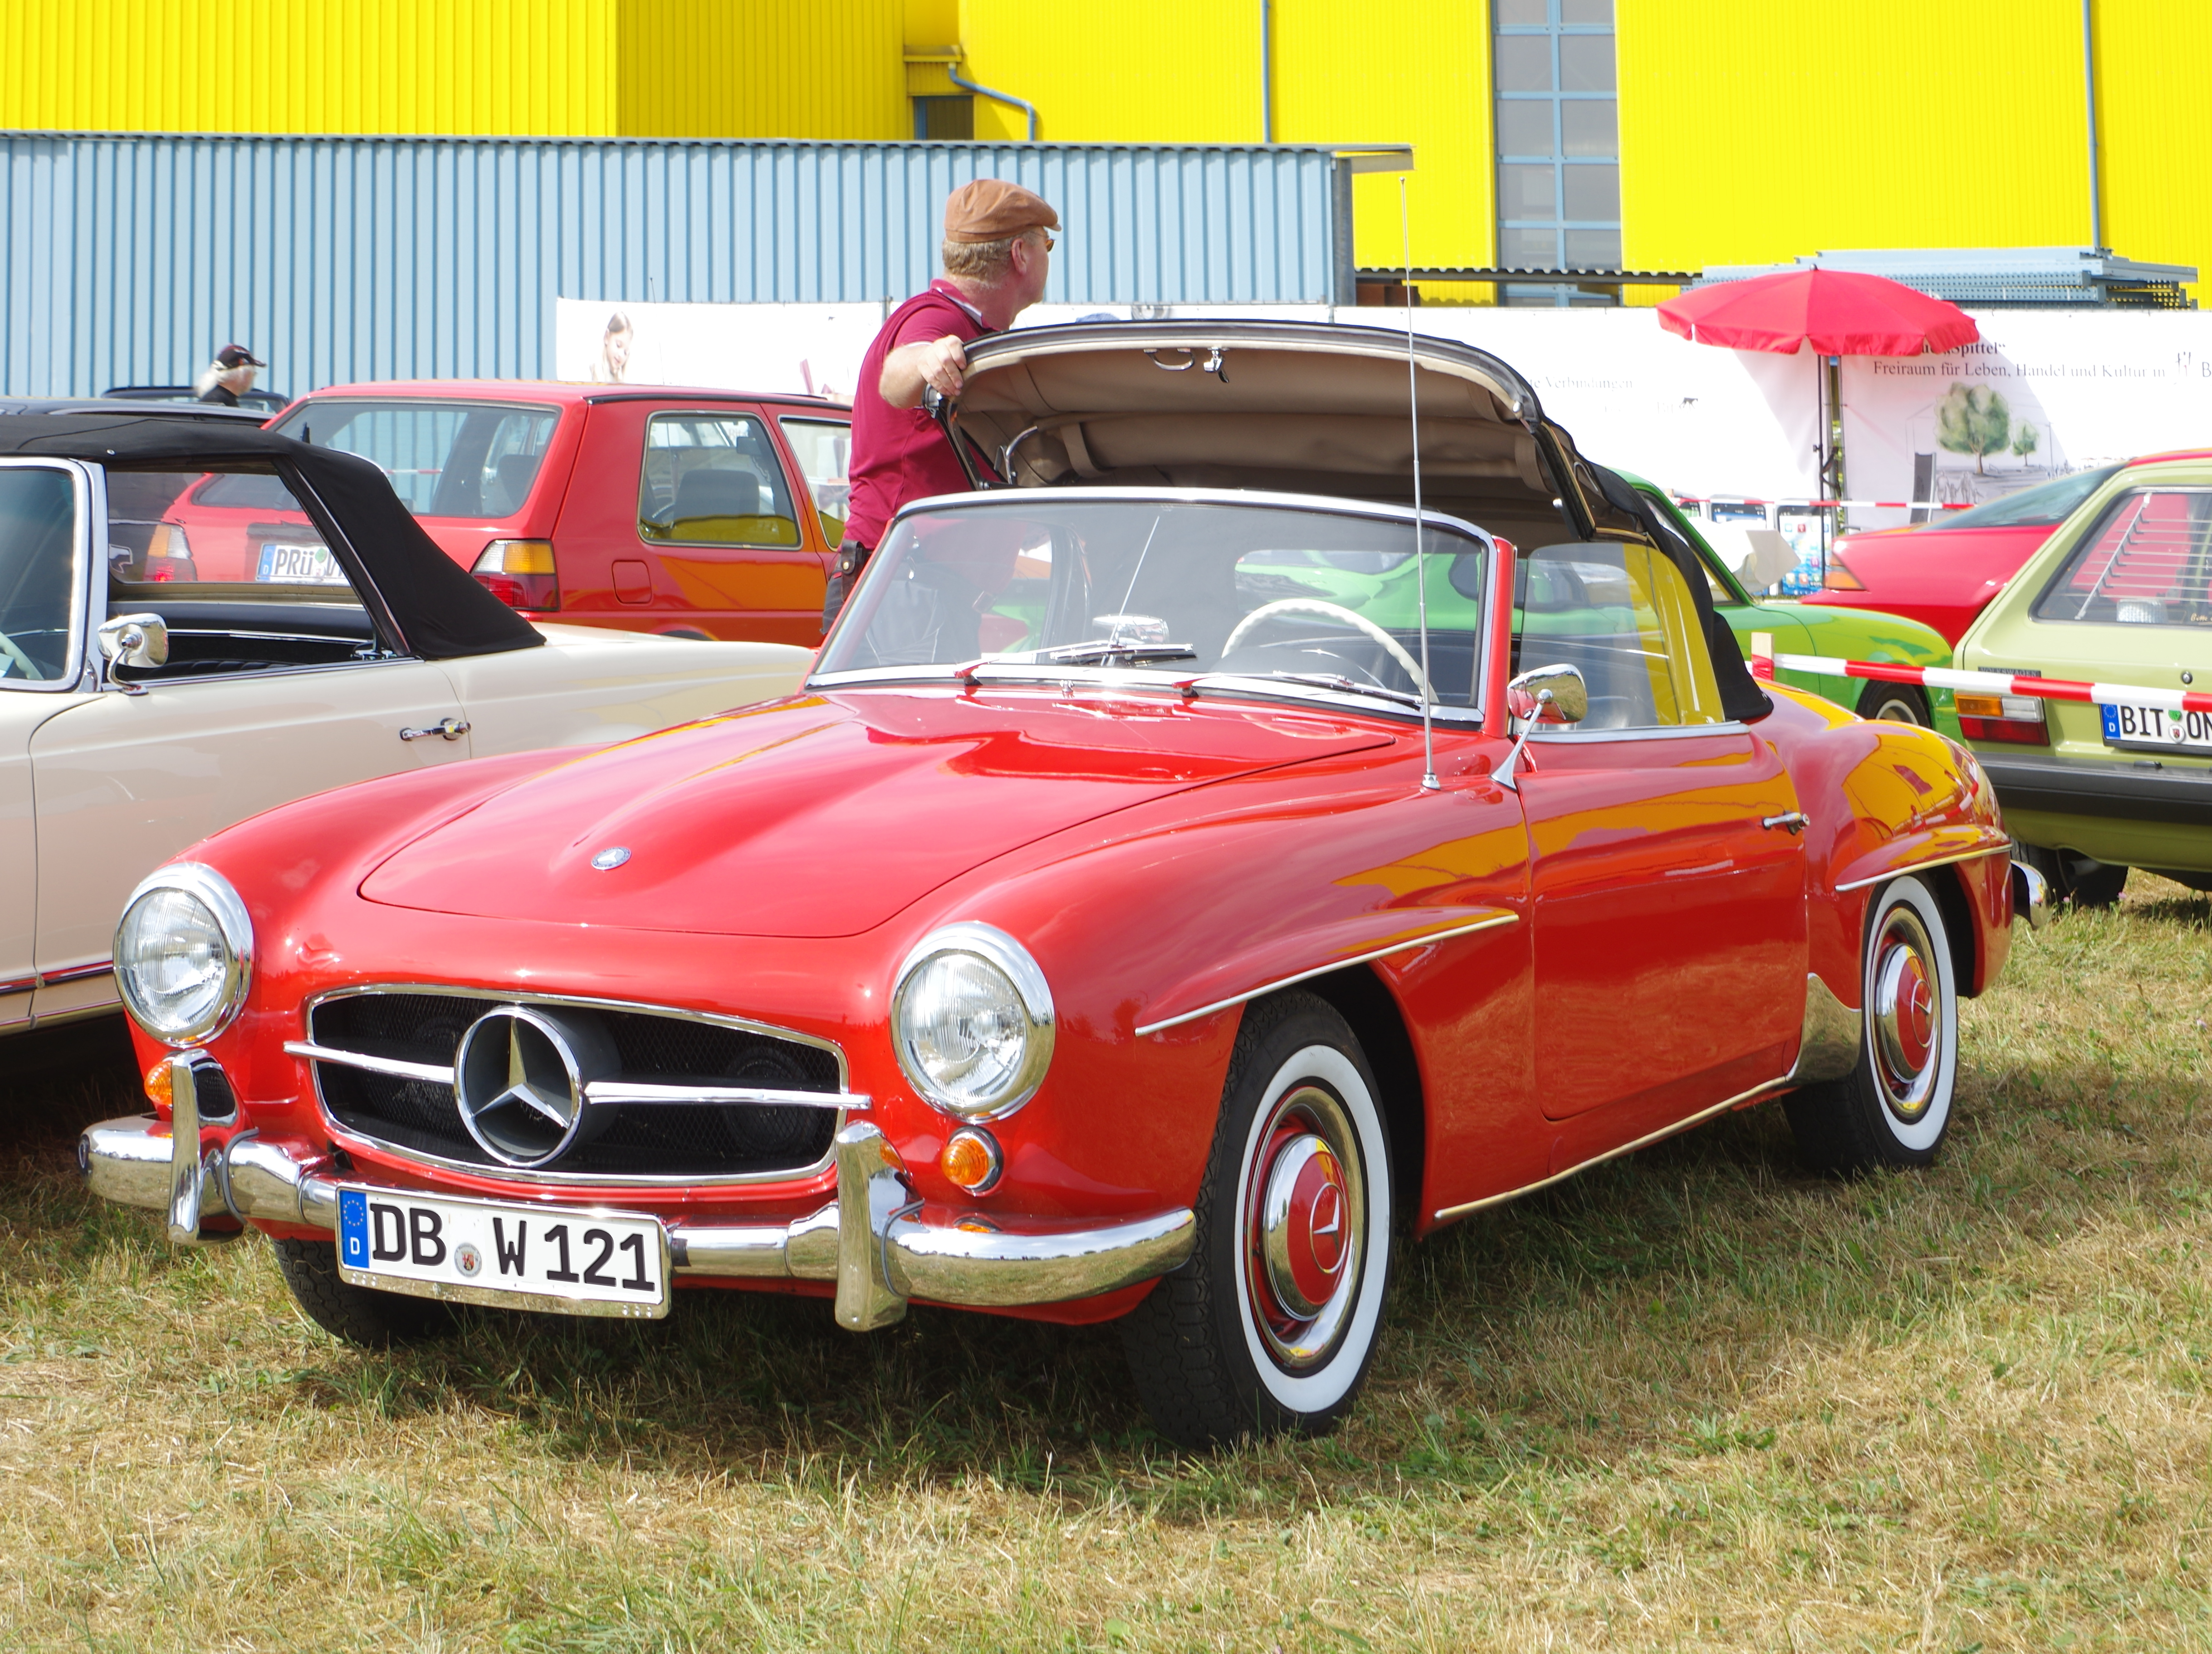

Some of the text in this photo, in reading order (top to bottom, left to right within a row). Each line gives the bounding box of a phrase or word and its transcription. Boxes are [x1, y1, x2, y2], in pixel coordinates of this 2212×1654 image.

[1874, 361, 1935, 374] Freiraum
[1941, 362, 1960, 375] für
[1965, 363, 2011, 378] Leben,
[2016, 363, 2064, 377] Handel
[2072, 365, 2095, 377] und
[2109, 722, 2116, 733] D
[2120, 705, 2163, 737] BIT
[350, 1237, 360, 1255] D
[370, 1203, 447, 1266] DB
[493, 1217, 527, 1277] W
[544, 1224, 656, 1292] 121
